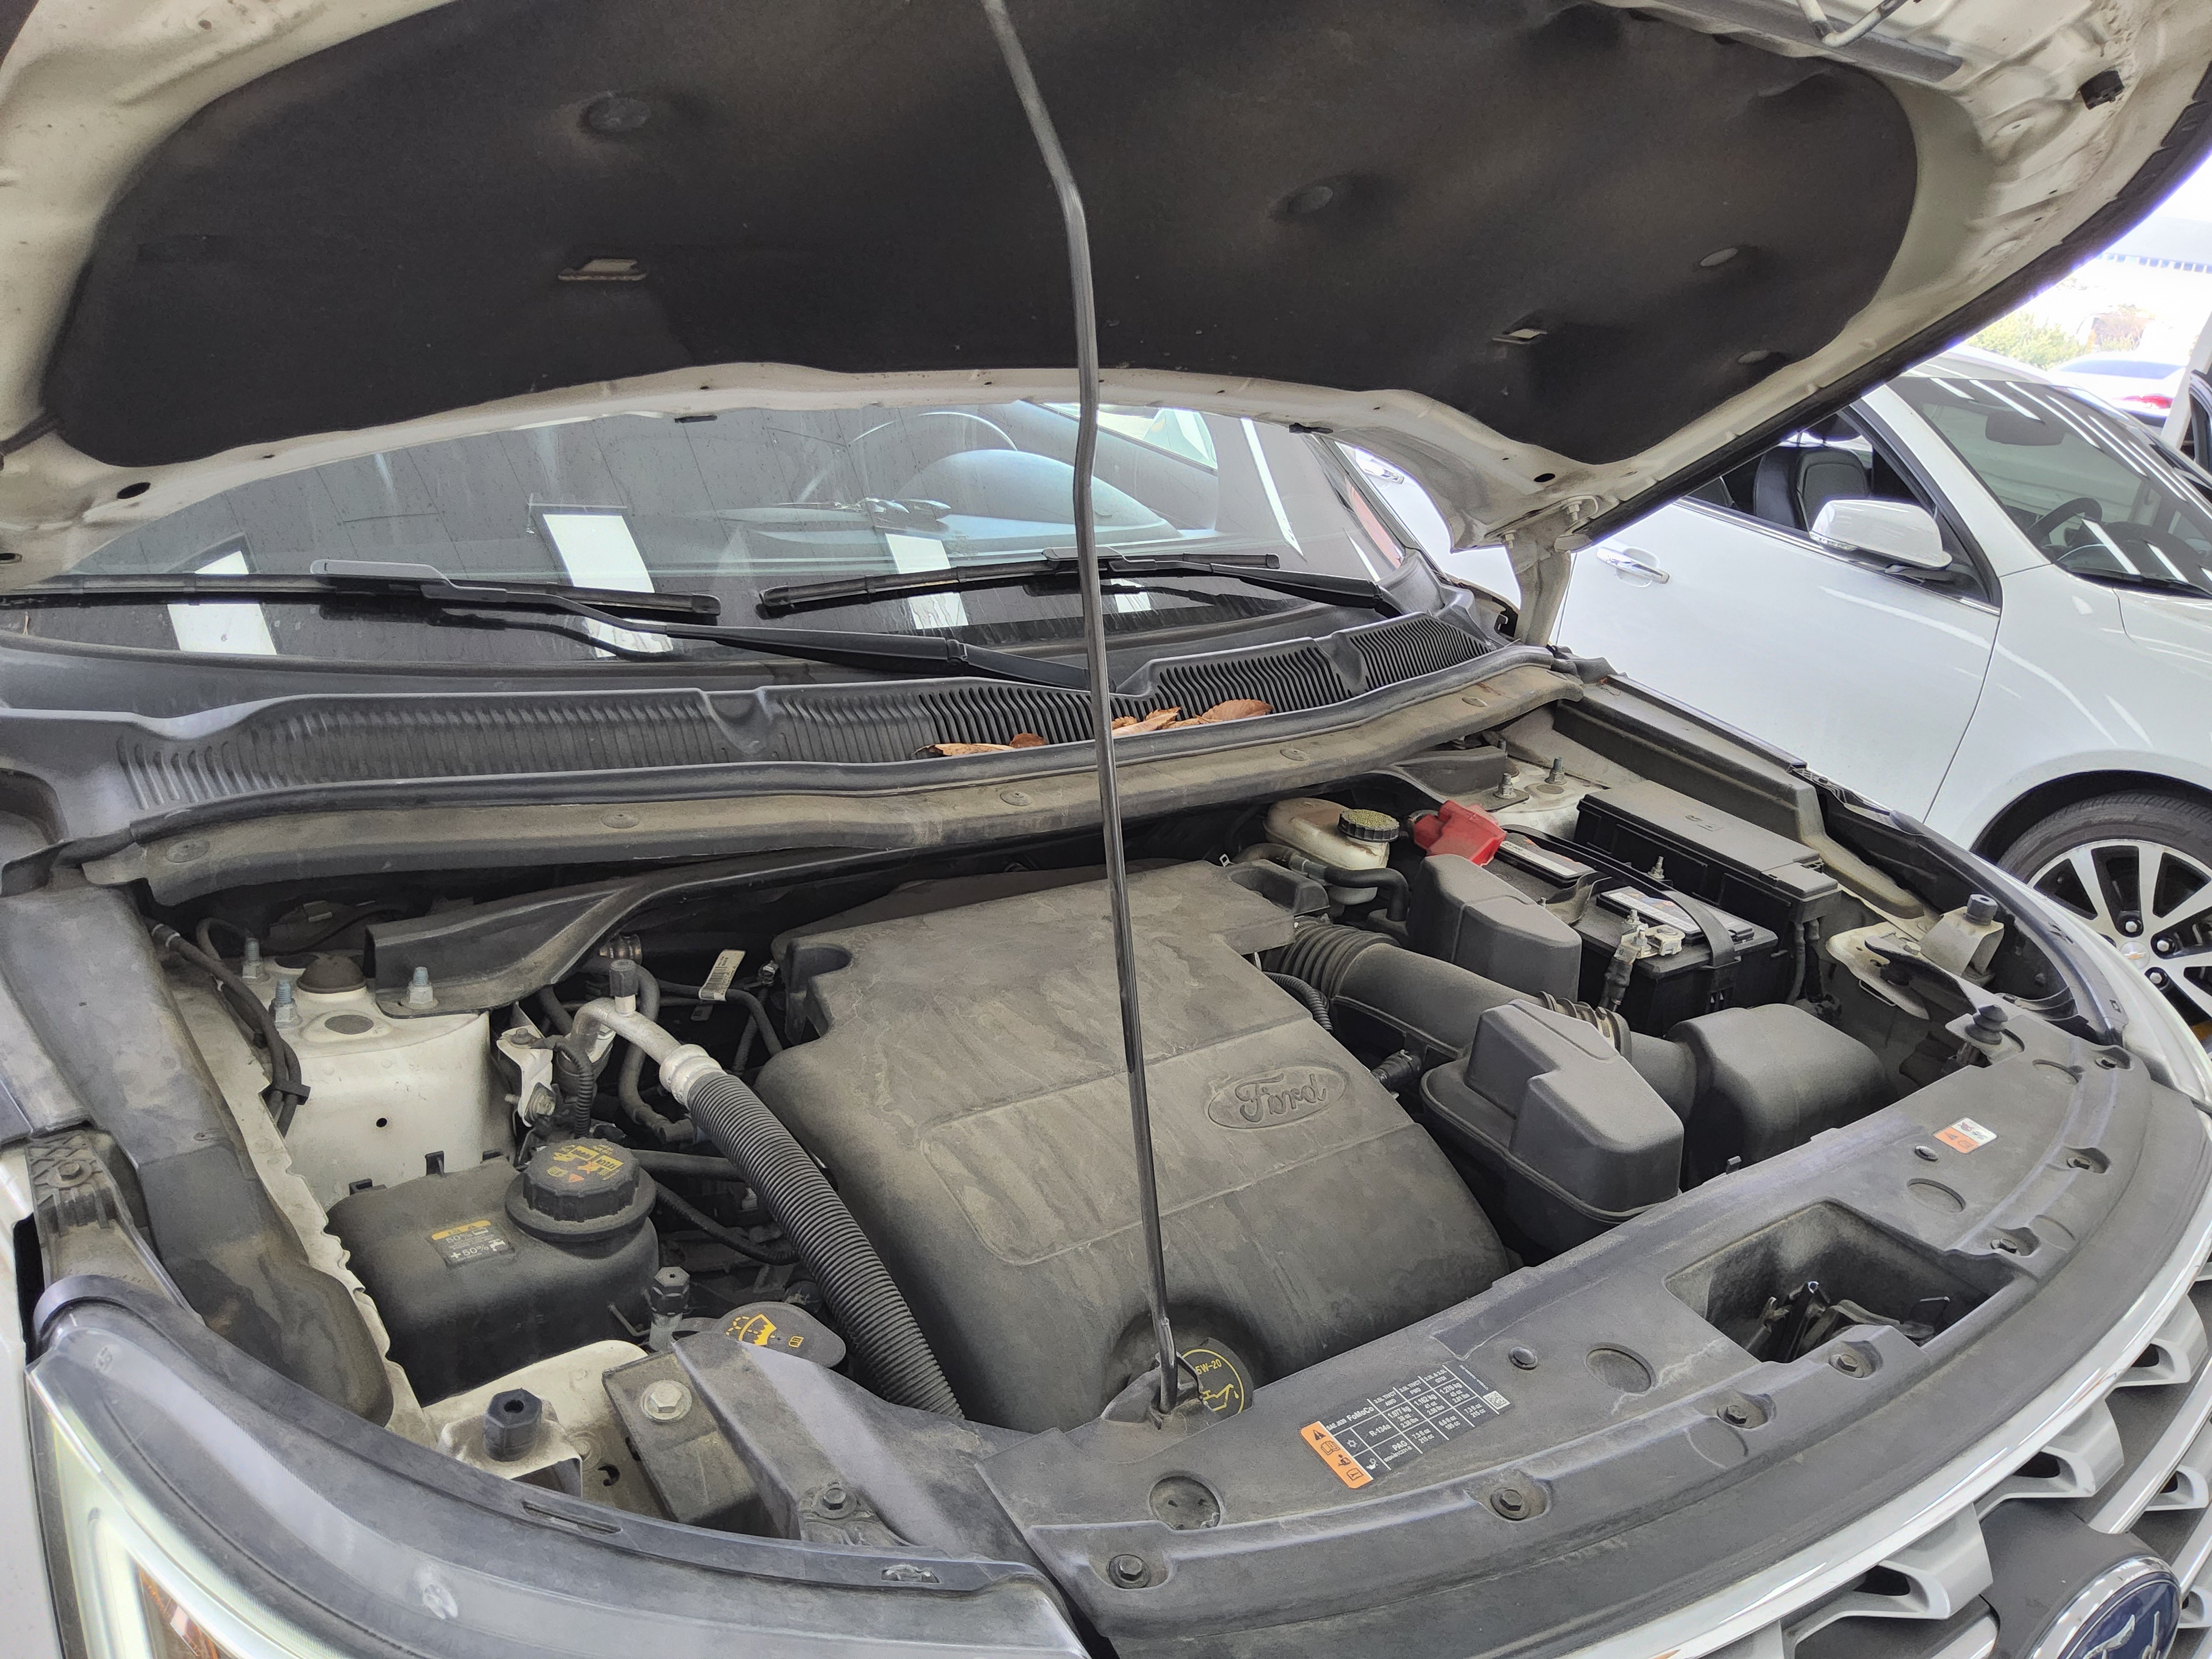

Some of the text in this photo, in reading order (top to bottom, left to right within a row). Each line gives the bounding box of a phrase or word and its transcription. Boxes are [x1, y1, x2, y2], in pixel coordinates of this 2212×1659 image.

[1235, 1073, 1327, 1123] Ford
[1195, 1358, 1222, 1375] 5W-20
[1414, 1396, 1430, 1406] 1.162
[1326, 1422, 1338, 1431] SAE
[1346, 1407, 1374, 1422] FoMoCo
[1387, 1408, 1403, 1418] 1.077
[1368, 1424, 1392, 1437] R-134a
[1392, 1440, 1408, 1451] PAG
